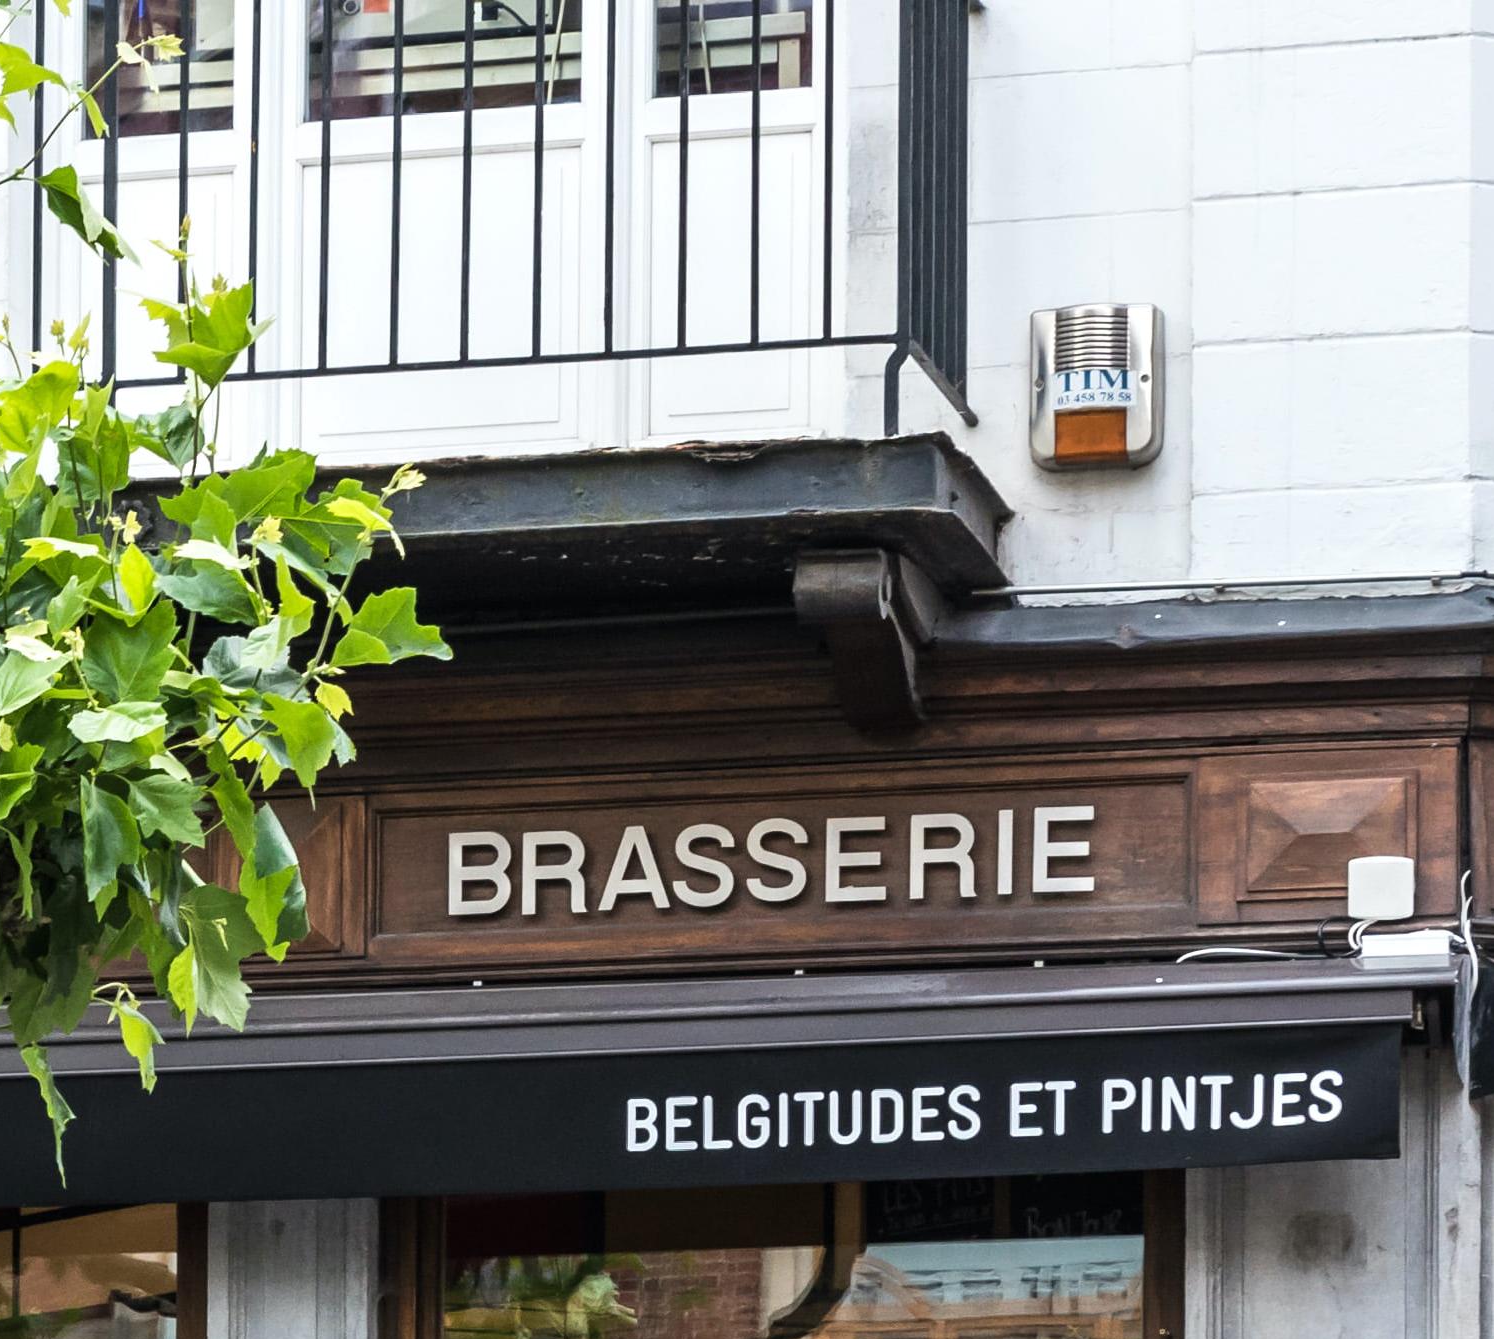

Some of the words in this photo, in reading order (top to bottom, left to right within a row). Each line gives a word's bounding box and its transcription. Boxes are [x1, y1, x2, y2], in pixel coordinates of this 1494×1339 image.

[1057, 369, 1130, 392] TIM
[448, 805, 1095, 916] BRASSERIE
[626, 1084, 981, 1152] BELGITUDES
[1009, 1080, 1077, 1138] ET
[1102, 1069, 1343, 1134] PINTJES
